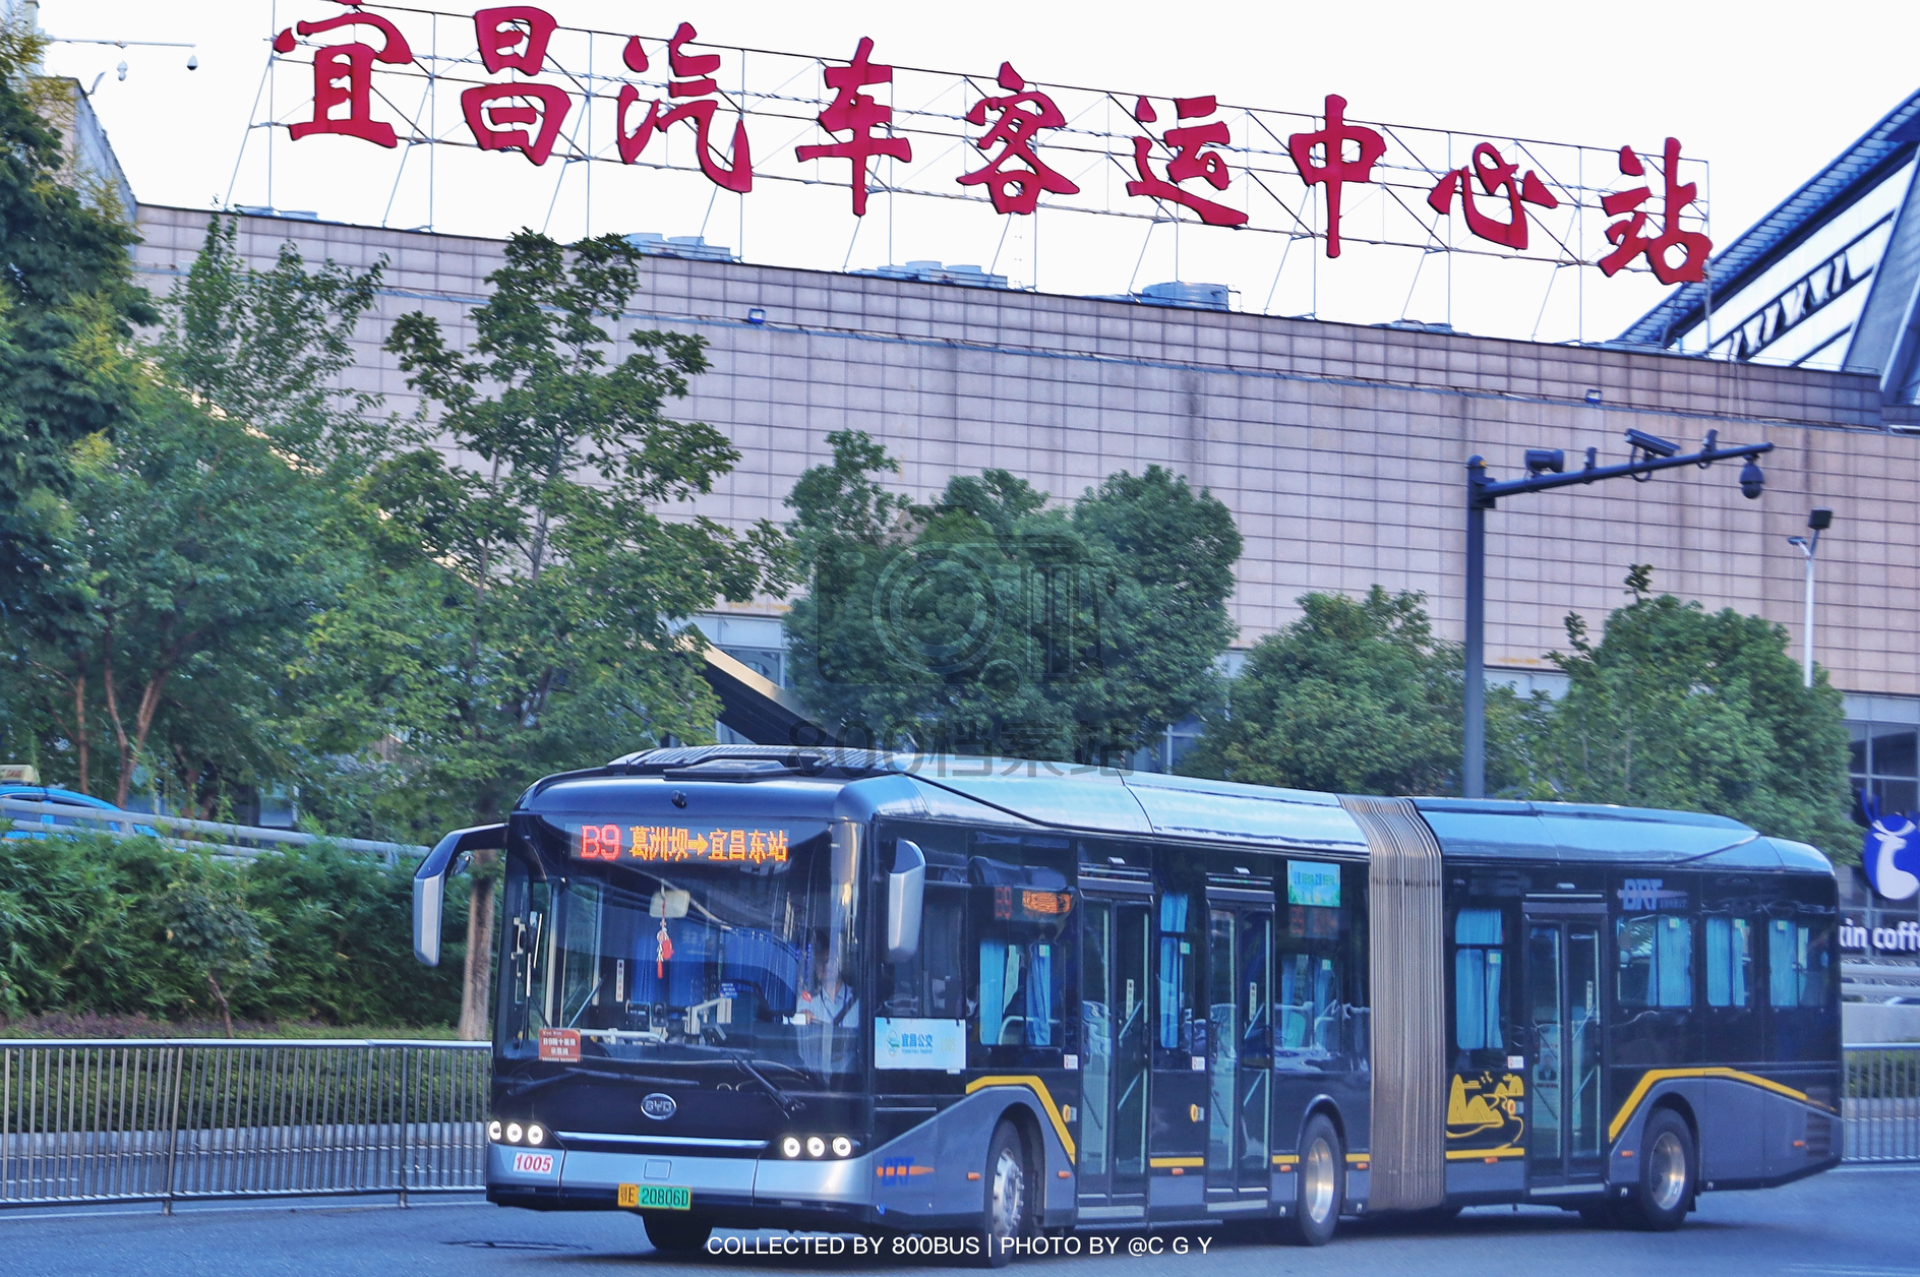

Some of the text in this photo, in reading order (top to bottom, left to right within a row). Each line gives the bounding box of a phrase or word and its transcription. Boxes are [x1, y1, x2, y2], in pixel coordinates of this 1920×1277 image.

[275, 0, 1711, 284] 宜昌汽车客运中心站
[581, 825, 789, 864] B9 葛洲坝 宜昌东站
[1872, 920, 1920, 951] coff
[645, 1100, 673, 1113] BYD
[515, 1154, 552, 1172] 1005
